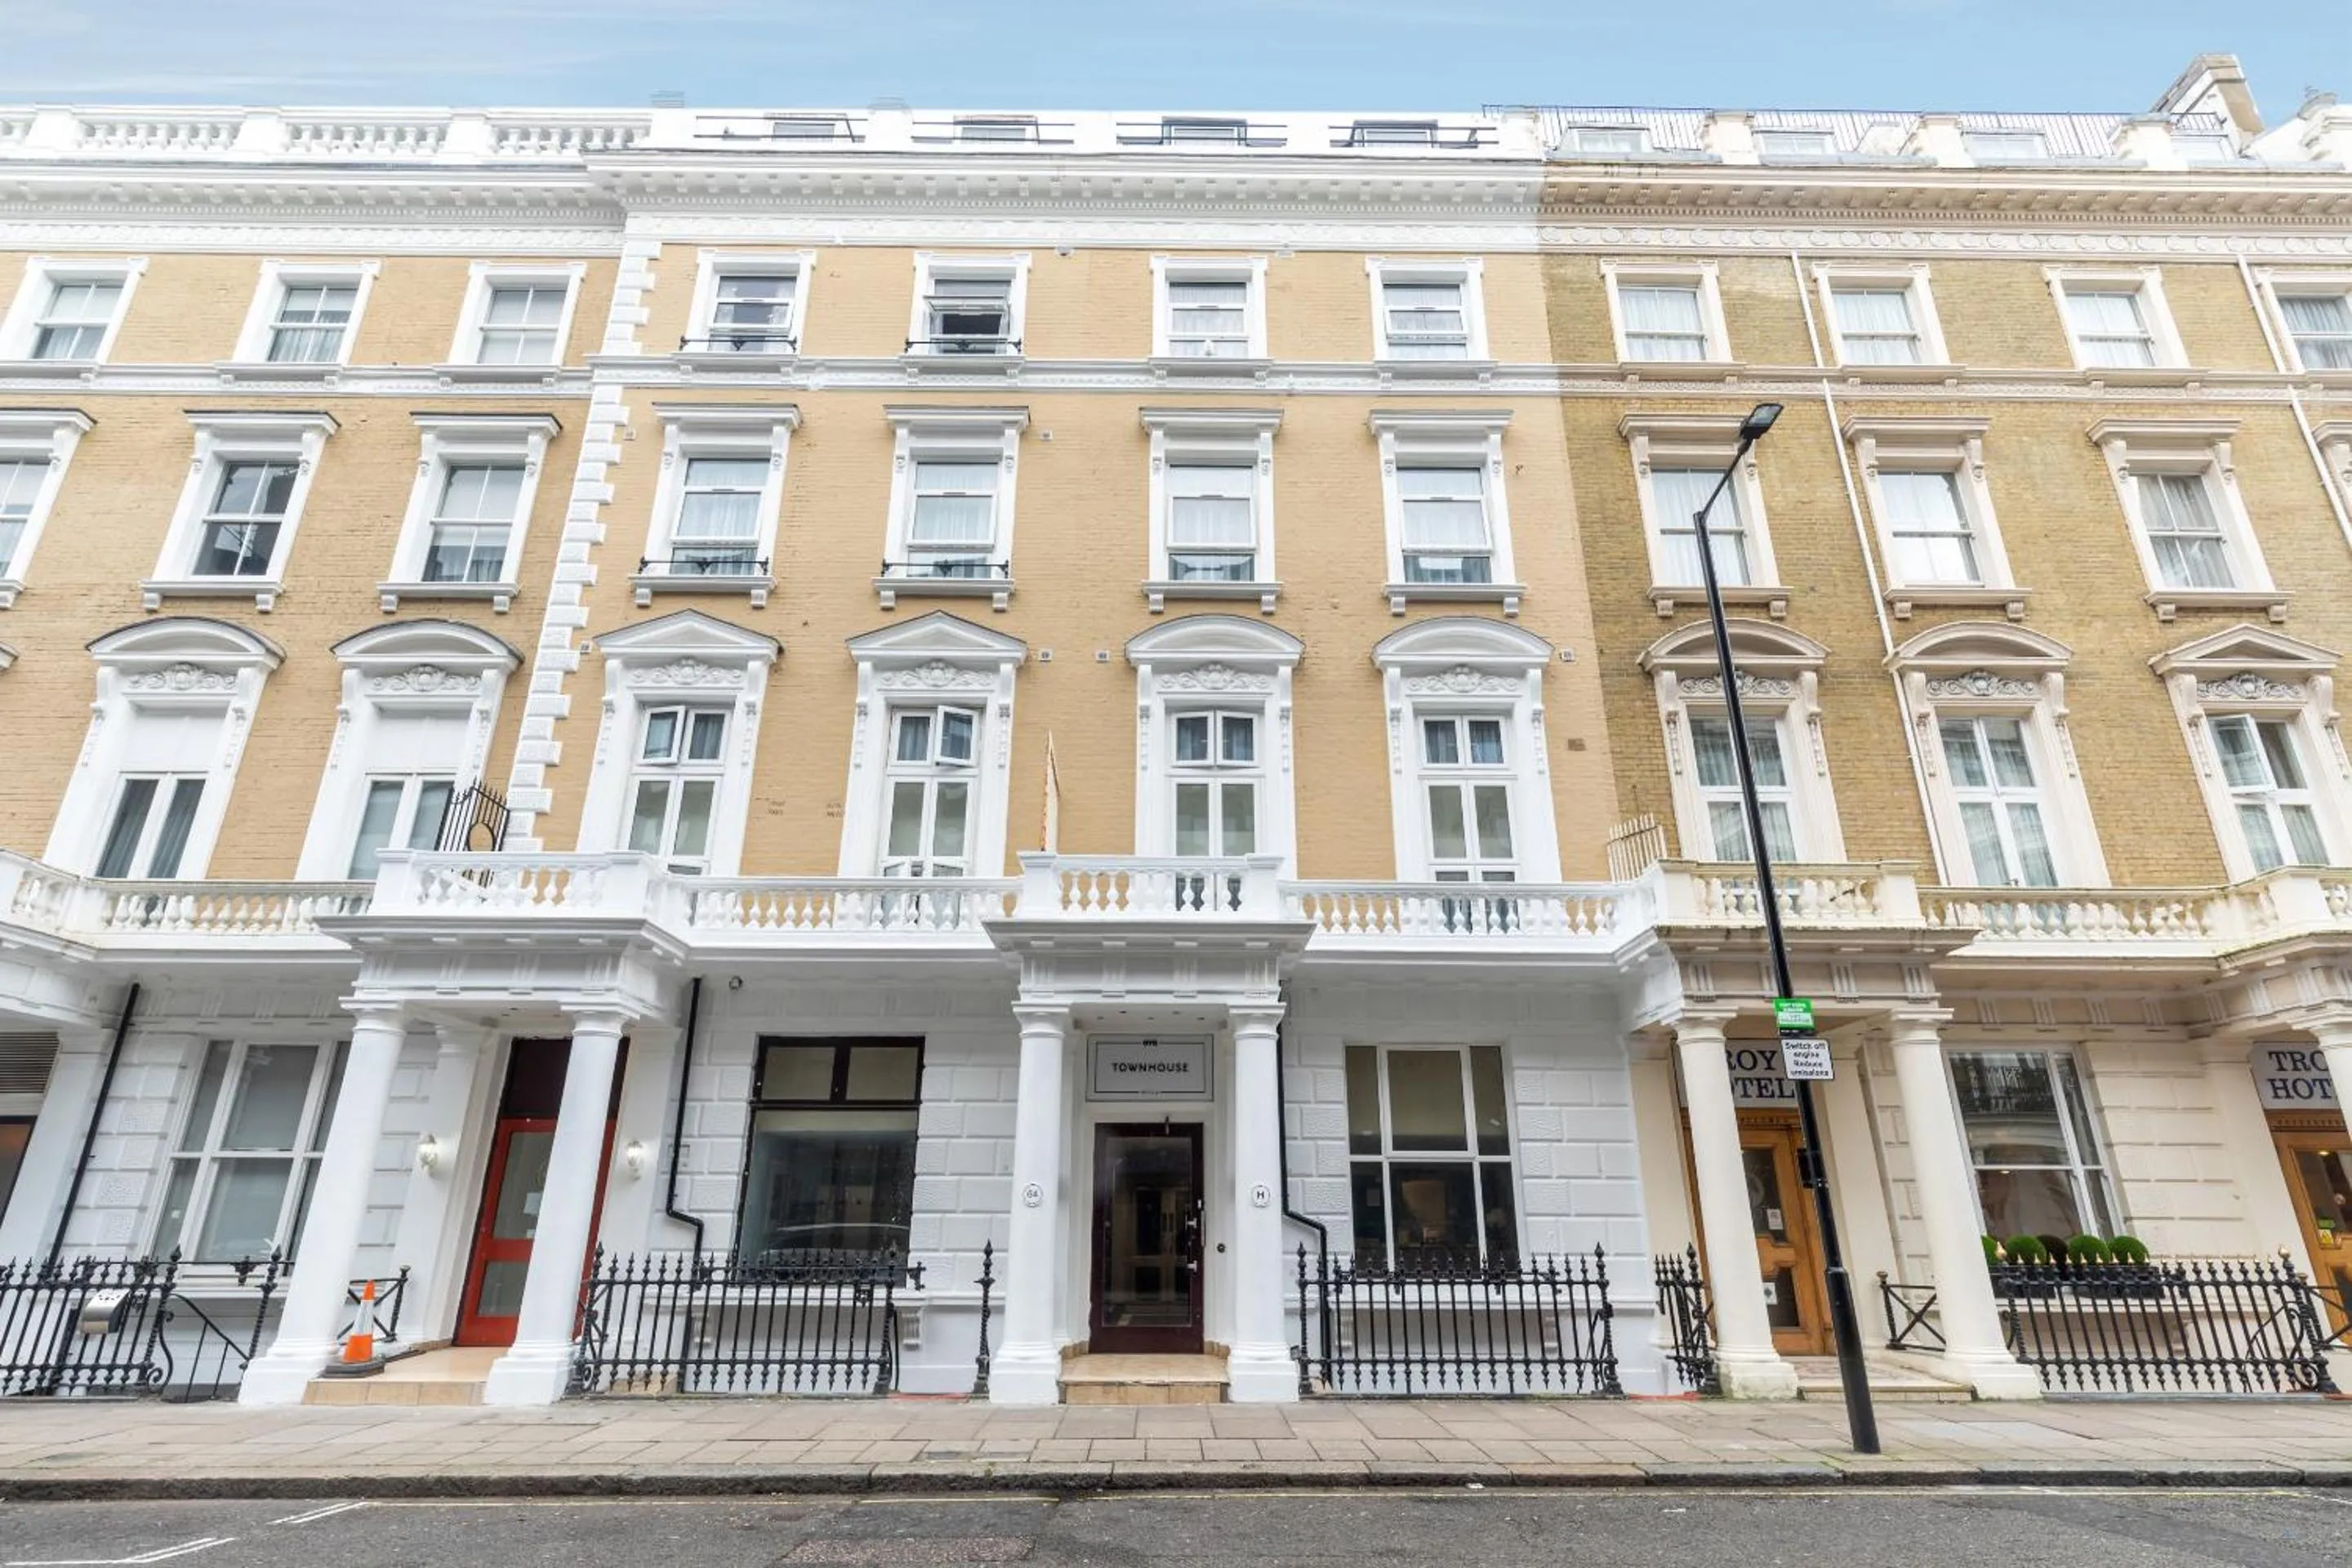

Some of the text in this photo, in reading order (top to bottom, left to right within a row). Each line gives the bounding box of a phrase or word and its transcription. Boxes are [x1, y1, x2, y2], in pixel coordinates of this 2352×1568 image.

[1111, 1062, 1189, 1072] TOWNHOUSE
[1731, 1077, 1795, 1098] TEL
[1257, 1191, 1264, 1199] H
